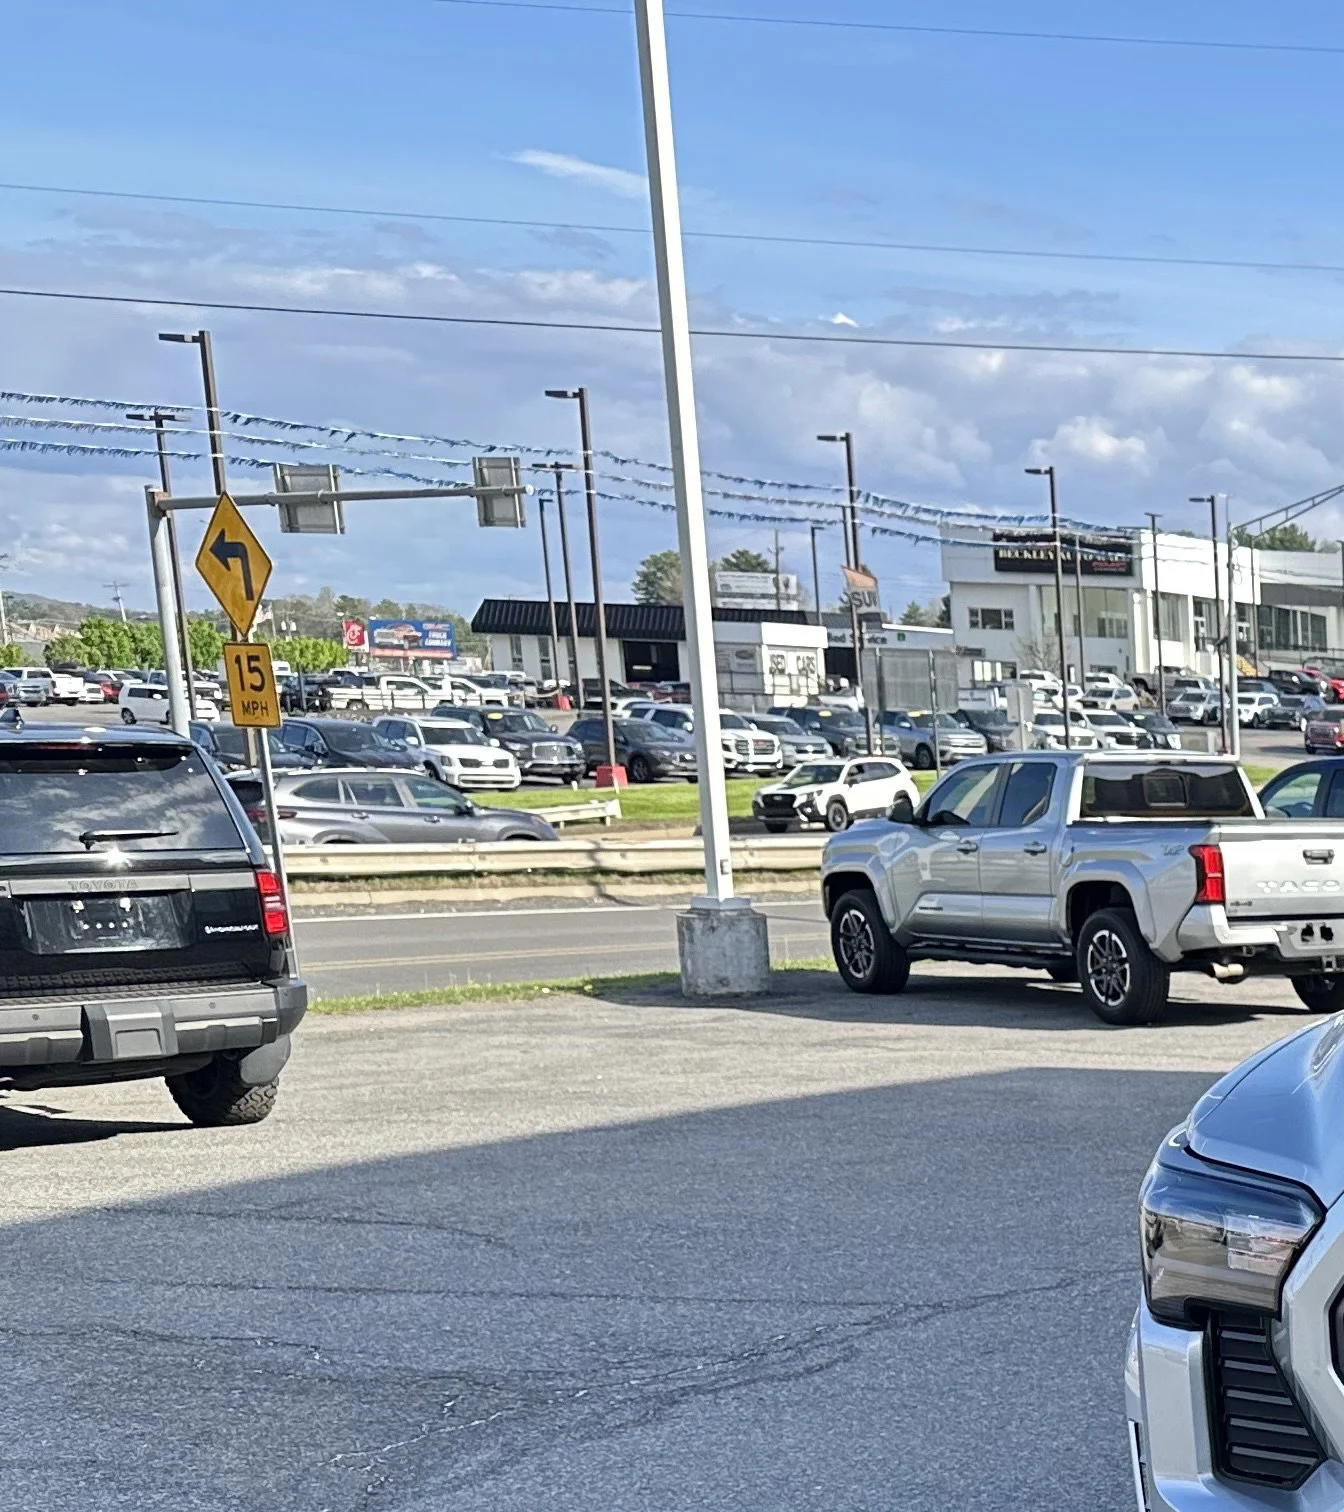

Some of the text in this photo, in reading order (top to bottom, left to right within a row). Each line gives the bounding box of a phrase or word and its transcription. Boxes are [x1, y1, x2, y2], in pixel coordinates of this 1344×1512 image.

[234, 654, 266, 693] 15
[241, 700, 270, 717] MPH
[67, 879, 139, 892] TOYOTA
